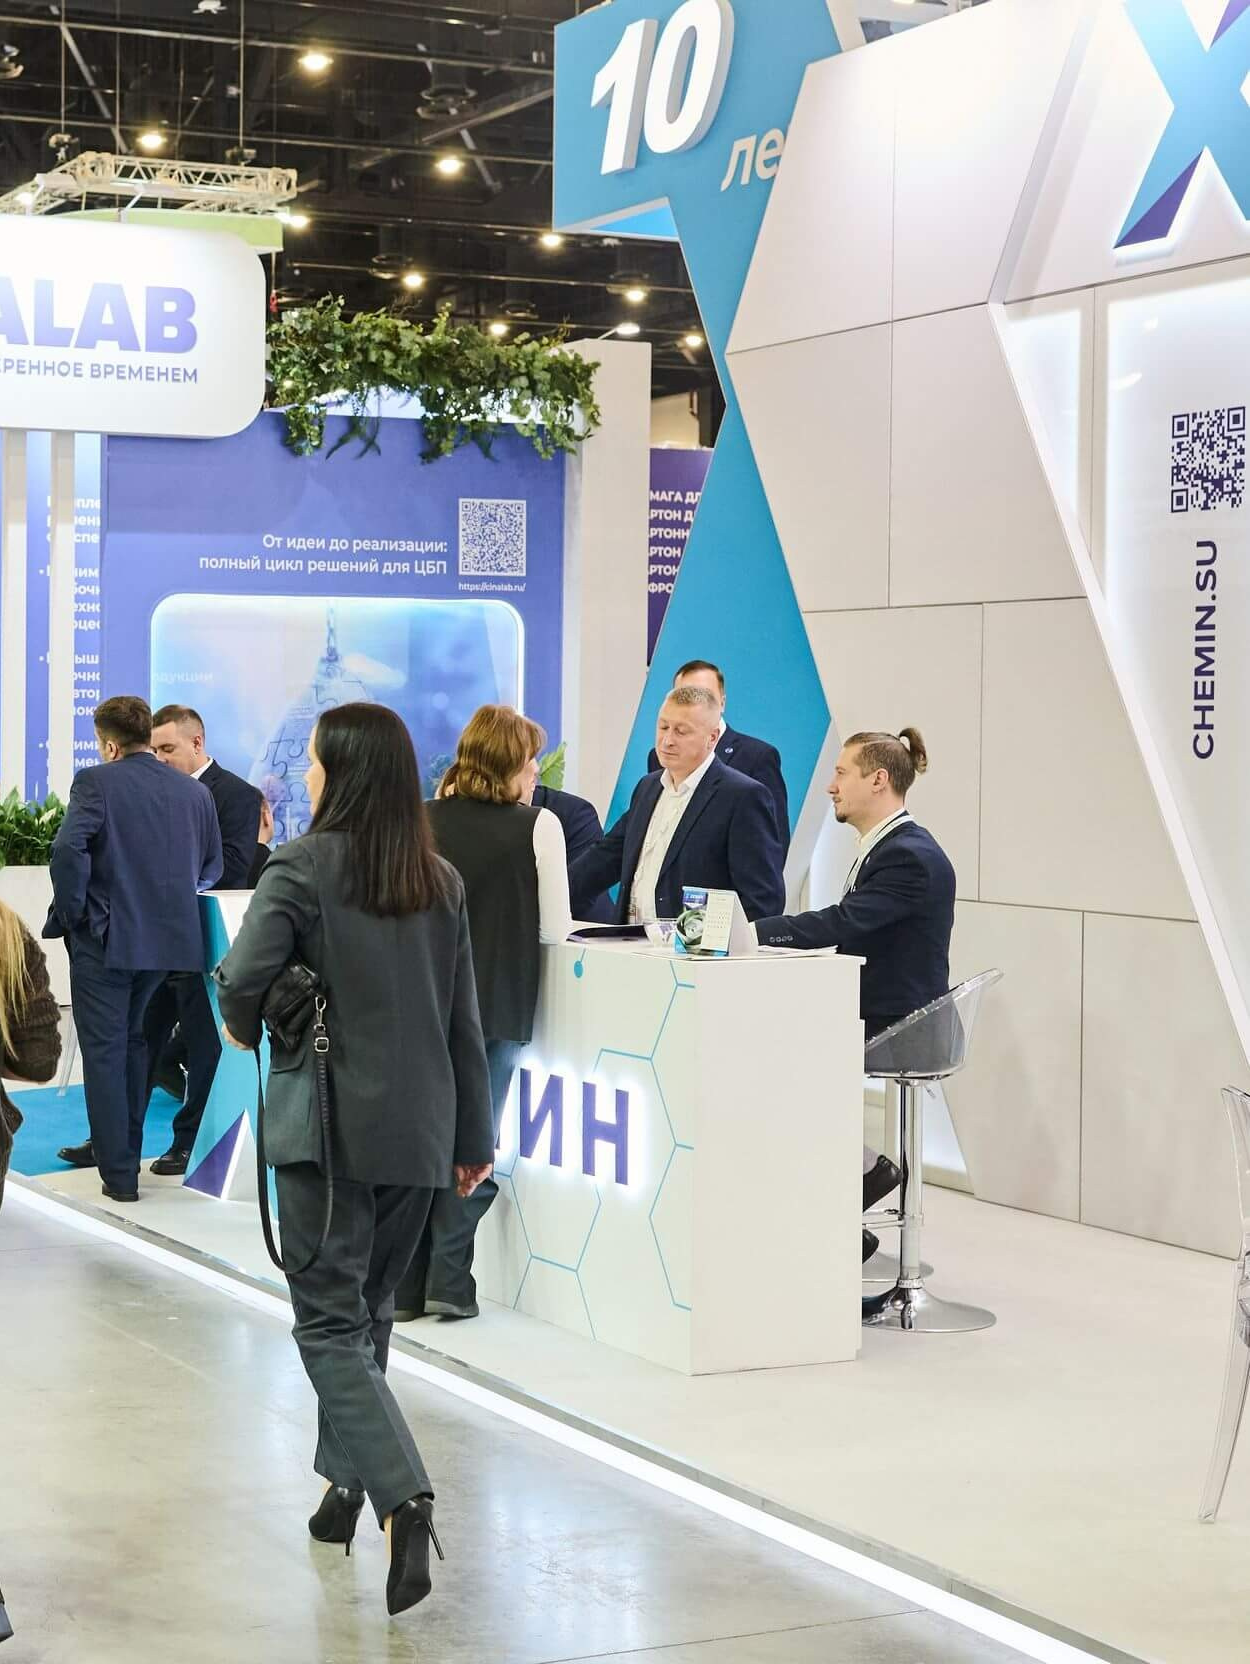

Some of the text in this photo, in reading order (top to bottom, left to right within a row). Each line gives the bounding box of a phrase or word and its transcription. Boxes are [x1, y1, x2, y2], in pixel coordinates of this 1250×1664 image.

[591, 0, 734, 175] 10
[720, 128, 786, 192] ле
[90, 363, 198, 384] ВРЕМЕНЕМ
[649, 490, 683, 502] МАГА
[649, 509, 681, 521] РТОН
[262, 534, 448, 553] От идеи до реализации:
[648, 528, 690, 539] РТОНН
[648, 546, 681, 558] РТОН
[199, 555, 447, 576] полный цикл решений для ЦБП
[648, 564, 680, 576] РТОН
[1193, 540, 1218, 759] CHEMIN.SU
[496, 1066, 630, 1186] ИН
